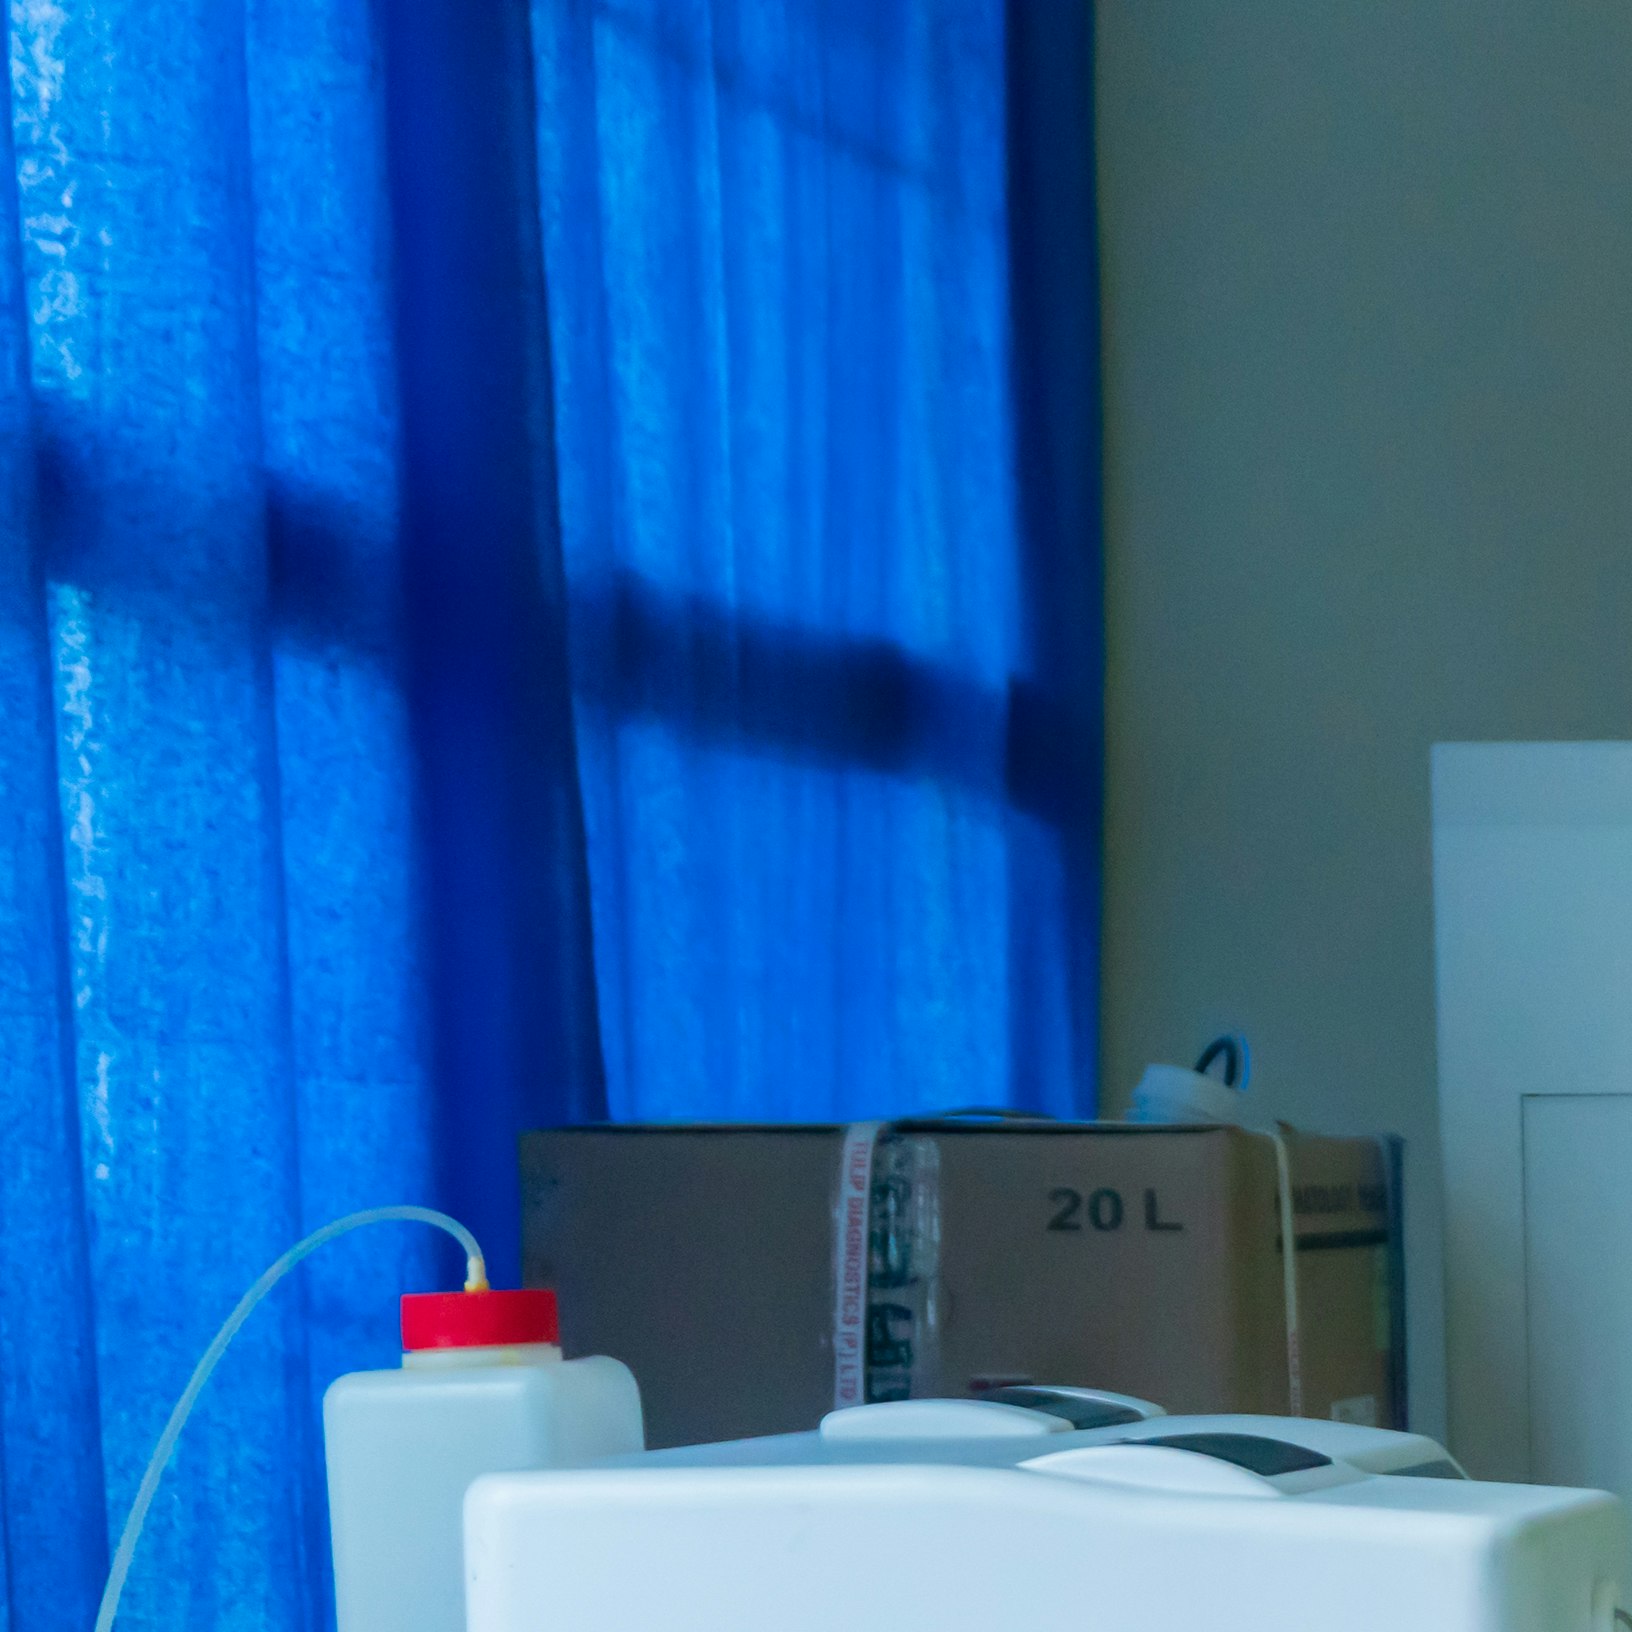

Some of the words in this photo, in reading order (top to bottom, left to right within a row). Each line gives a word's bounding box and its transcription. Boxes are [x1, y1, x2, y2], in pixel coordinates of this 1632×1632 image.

[1047, 1187, 1123, 1231] 20
[1144, 1187, 1184, 1231] L
[842, 1197, 864, 1327] DIAGNOSTICS
